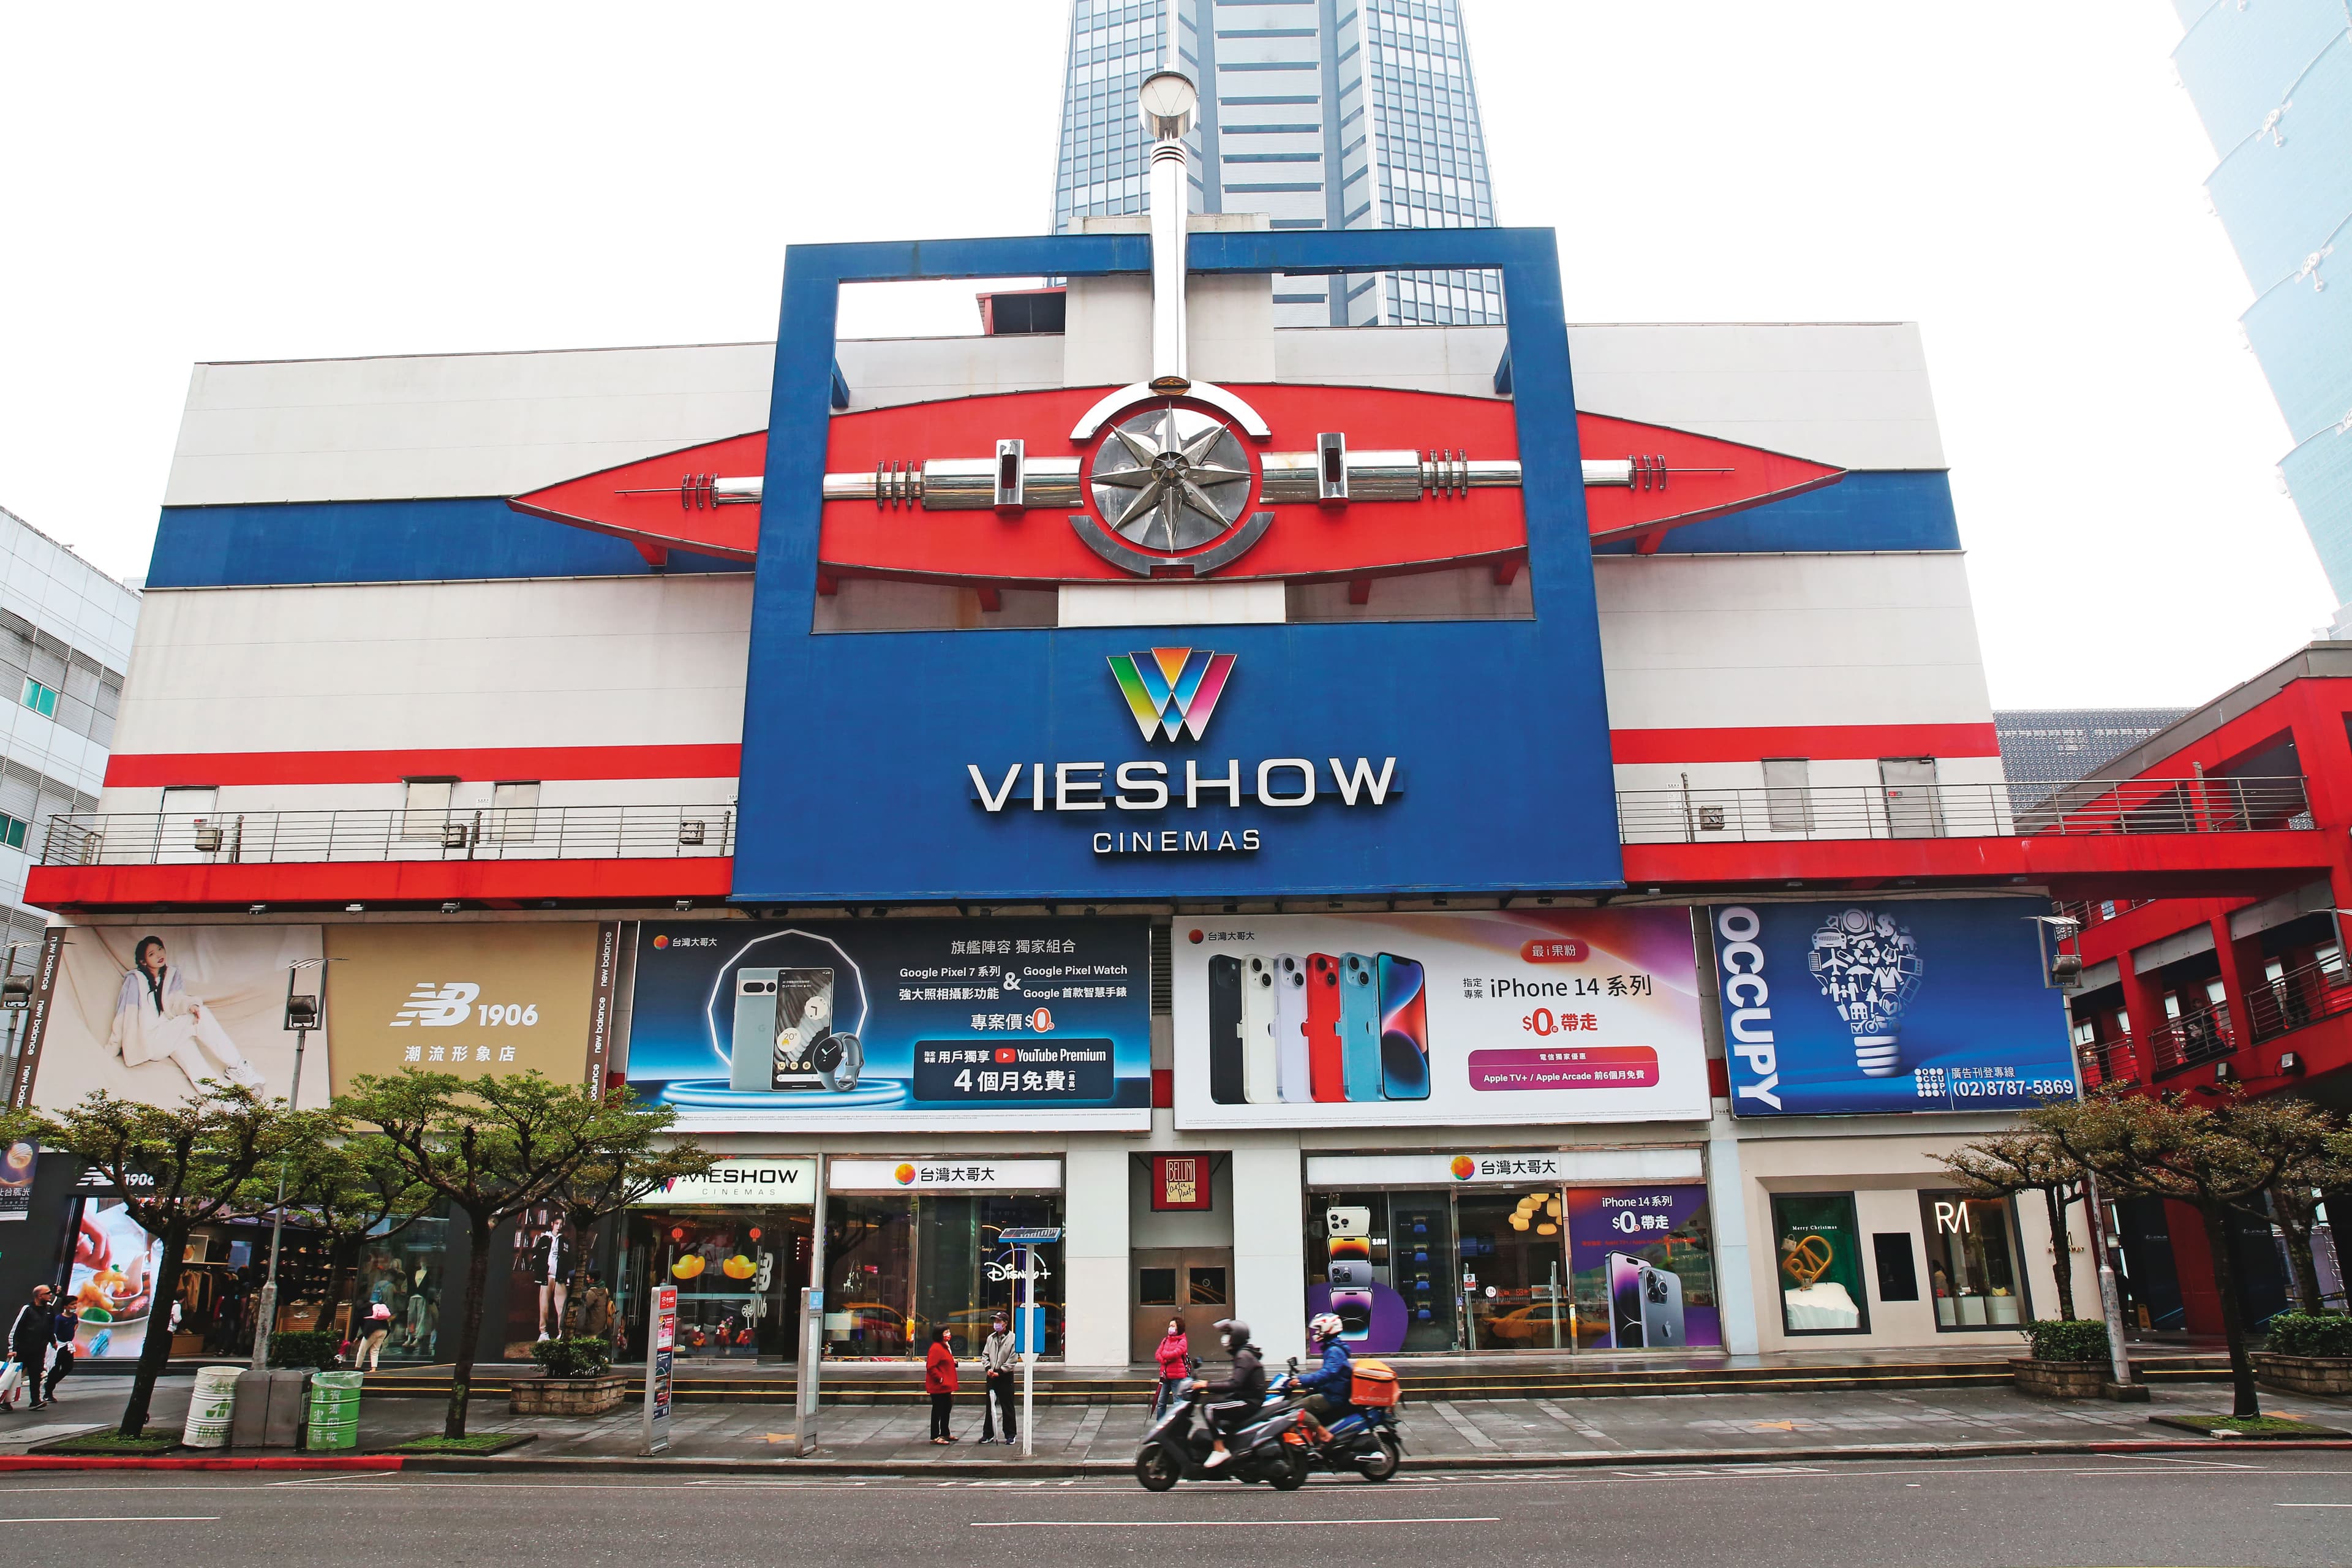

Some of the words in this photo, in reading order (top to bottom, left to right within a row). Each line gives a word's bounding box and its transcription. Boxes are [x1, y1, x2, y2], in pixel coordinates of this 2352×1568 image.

[967, 757, 1396, 812] VIESHOW
[1093, 829, 1261, 854] CINEMAS
[673, 938, 717, 947] 台灣大哥大
[1208, 932, 1254, 941] 台灣大哥大
[601, 932, 612, 968] balance
[951, 940, 1011, 954] 旗艦陣容
[1016, 939, 1076, 954] 獨家組合
[41, 955, 56, 990] balance
[900, 968, 938, 979] Google
[941, 967, 967, 978] Pixel
[969, 967, 975, 976] 7
[978, 965, 1001, 977] 系列
[1003, 971, 1021, 990] &
[1023, 966, 1062, 978] Google
[1065, 966, 1091, 976] Pixel
[1093, 965, 1128, 975] Watch
[1463, 978, 1482, 987] 指定
[1490, 978, 1568, 998] iPhone
[1575, 978, 1600, 996] 14
[1607, 974, 1652, 997] 系列
[899, 987, 1000, 1001] 強大照相攝影功能
[1023, 989, 1060, 1000] Google
[1062, 986, 1127, 999] 首款智慧手錶
[1464, 989, 1483, 999] 專案
[36, 1000, 45, 1018] new
[478, 1004, 539, 1027] 1906
[595, 997, 606, 1033] balance
[1719, 907, 1782, 1110] OCCUPY
[970, 1013, 1023, 1031] 專案價
[1523, 1008, 1554, 1036] $0
[1561, 1013, 1598, 1031] 帶走
[28, 1019, 42, 1055] balance
[404, 1045, 516, 1063] 潮流形象店
[938, 1050, 990, 1064] 用戶獨享
[1017, 1049, 1058, 1063] YouTube
[1060, 1048, 1106, 1061] Premium
[1539, 1052, 1586, 1061] 電信獨家優惠
[21, 1065, 31, 1084] new
[954, 1069, 973, 1092] 4
[977, 1070, 1066, 1092] 個月免費
[1483, 1074, 1508, 1083] Apple
[1536, 1072, 1560, 1082] Apple
[1562, 1072, 1591, 1080] Arcade
[1594, 1070, 1645, 1080] 前6個月免費
[1951, 1066, 2016, 1079] 廣告刊登專線
[1953, 1079, 2074, 1097] (02)8787-5869
[921, 1167, 995, 1182] 台灣大哥大
[1169, 1161, 1193, 1182] BELLINI
[1481, 1159, 1556, 1175] 台灣大哥大
[1602, 1197, 1636, 1207] iPhone
[1638, 1197, 1649, 1206] 14
[1651, 1196, 1672, 1207] 系列
[1612, 1211, 1636, 1233] $0
[1641, 1215, 1669, 1229] 帶走
[984, 1262, 1052, 1282] Disny+
